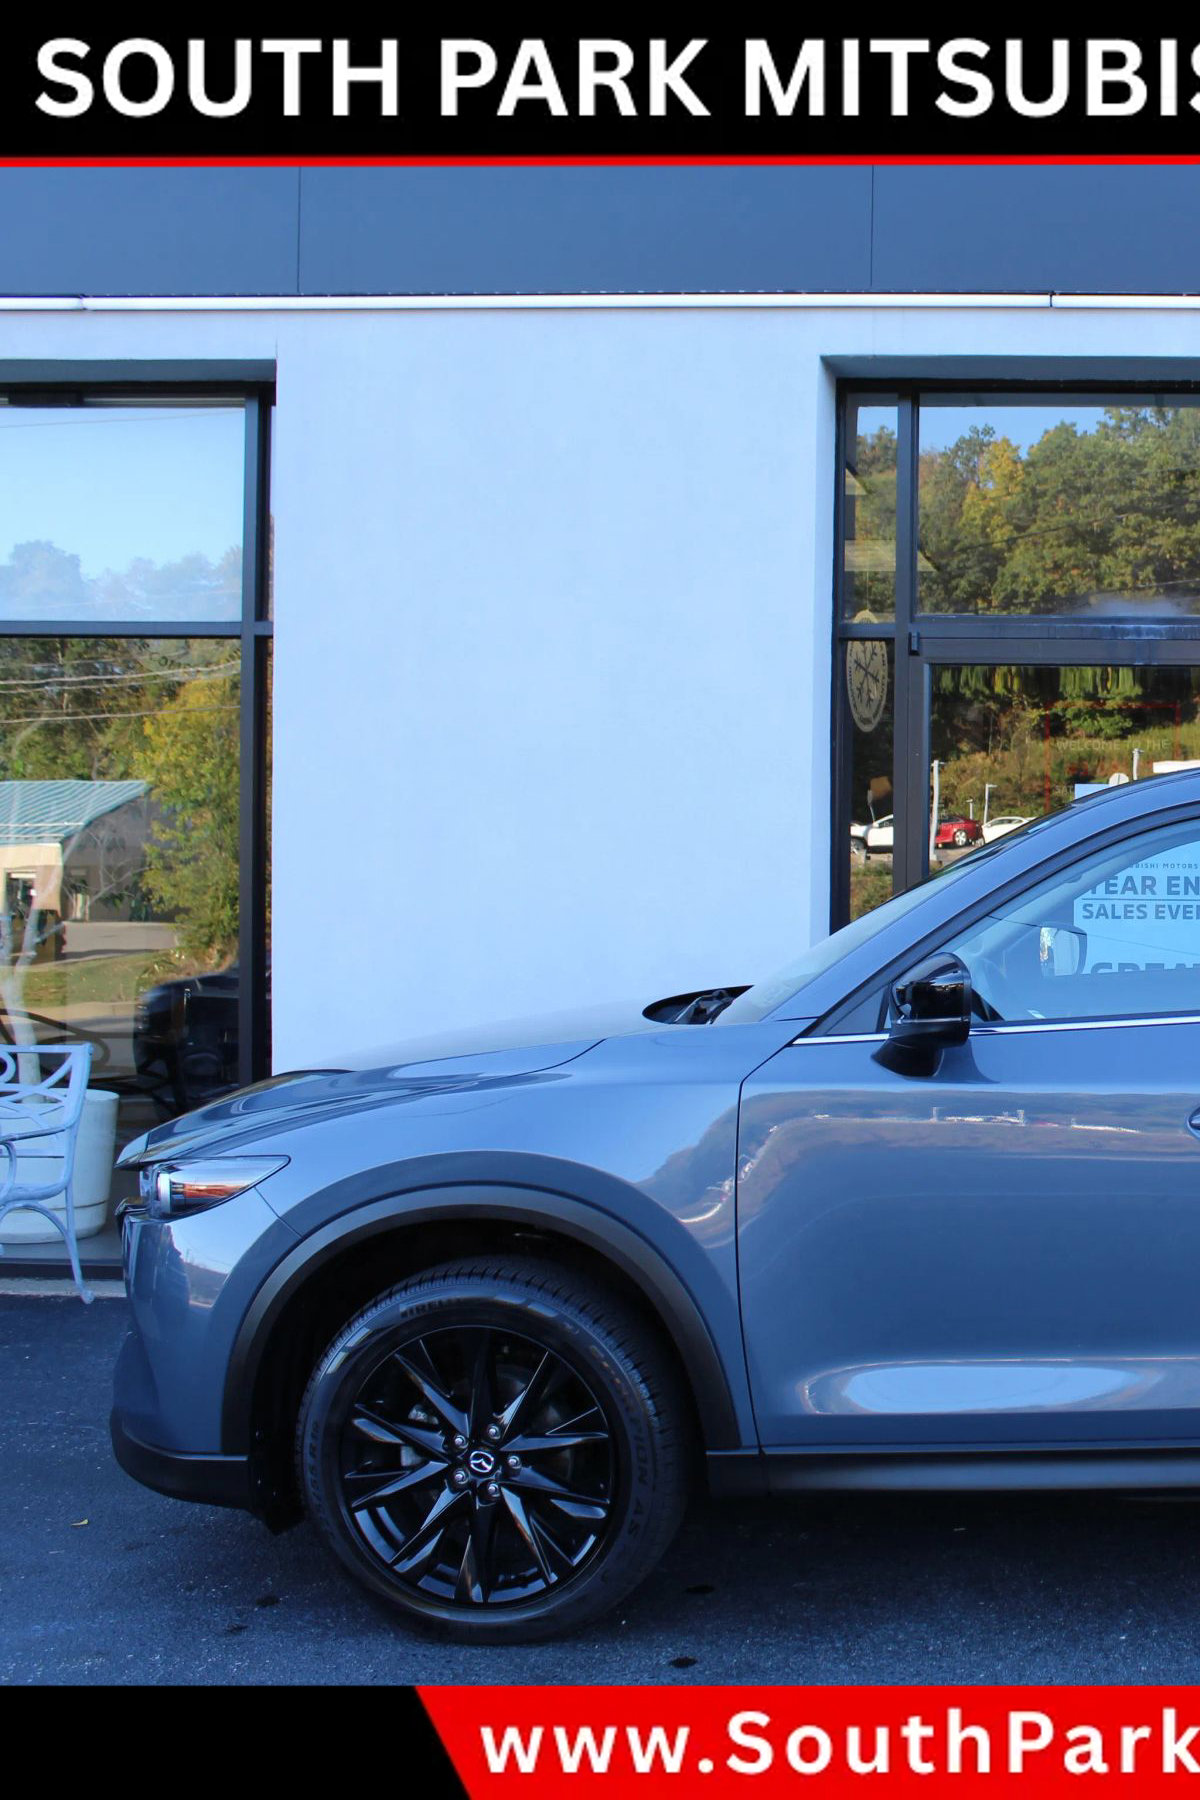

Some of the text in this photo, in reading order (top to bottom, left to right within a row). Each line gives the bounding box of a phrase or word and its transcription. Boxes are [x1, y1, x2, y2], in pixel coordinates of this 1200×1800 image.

[1056, 739, 1121, 750] WELCOME
[1146, 740, 1170, 750] THE
[1082, 903, 1148, 920] SALES
